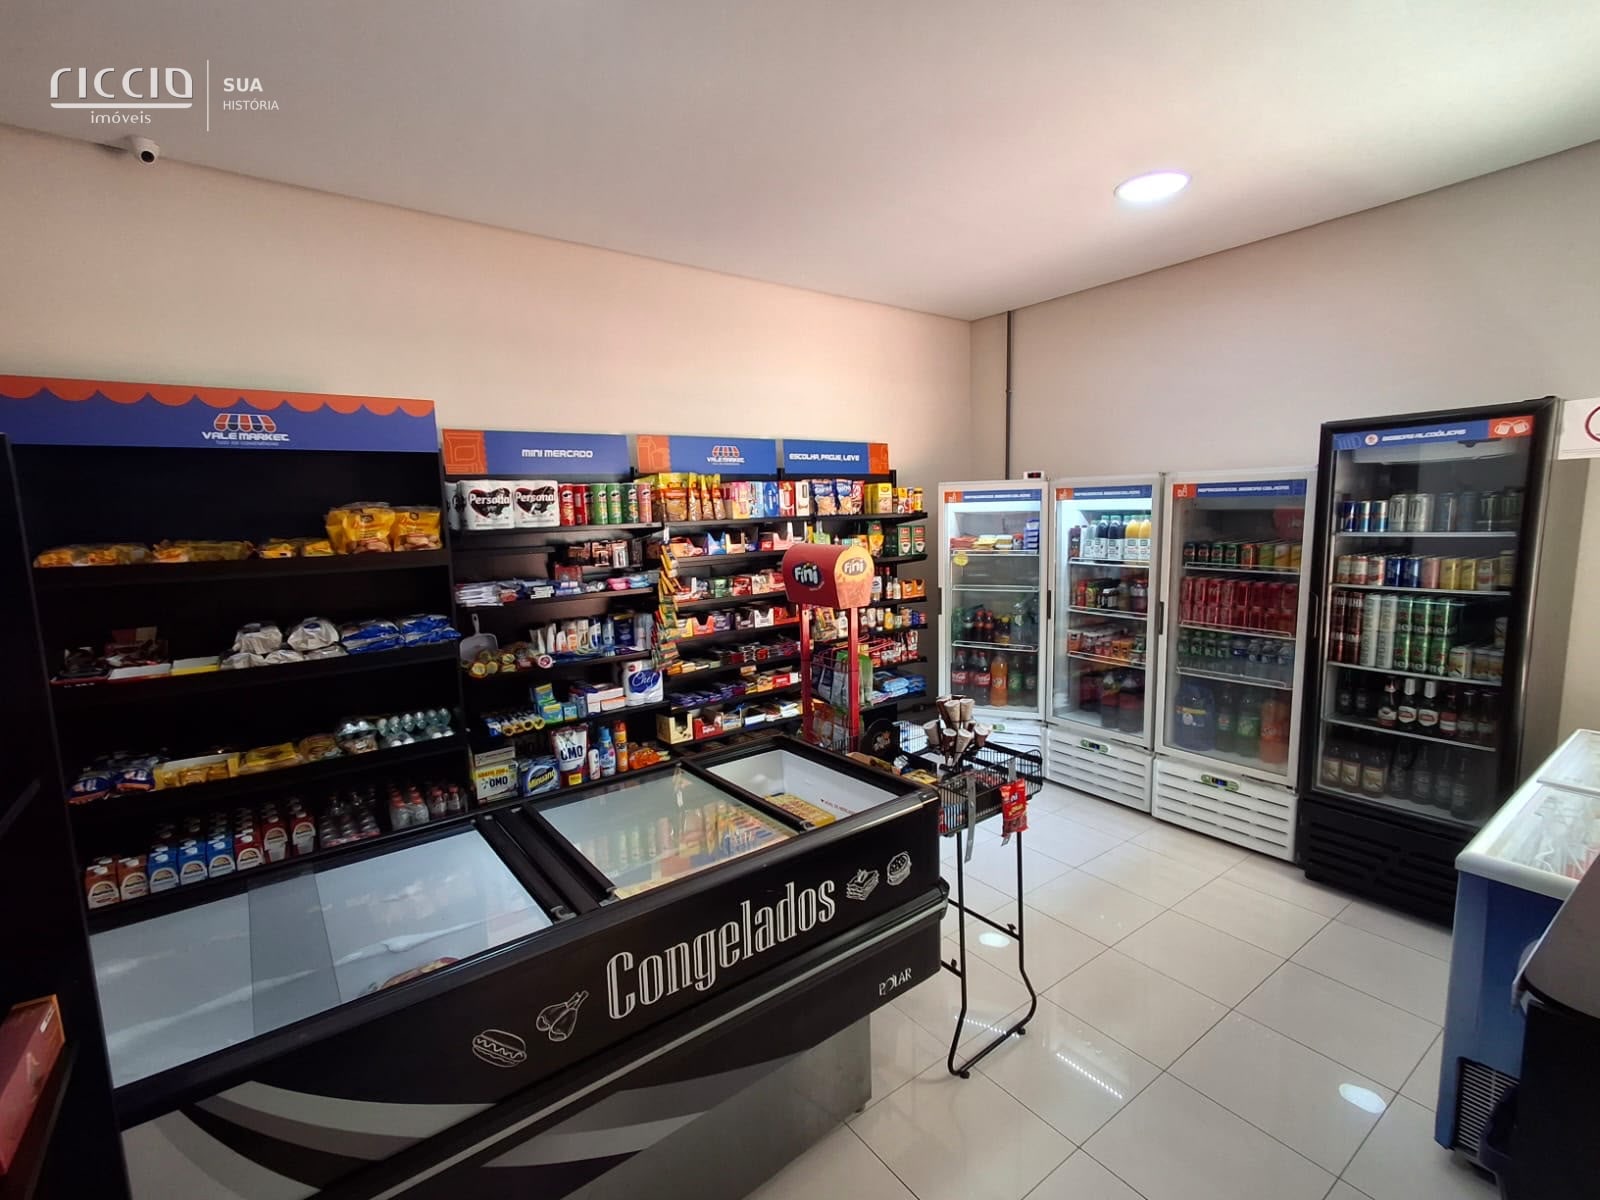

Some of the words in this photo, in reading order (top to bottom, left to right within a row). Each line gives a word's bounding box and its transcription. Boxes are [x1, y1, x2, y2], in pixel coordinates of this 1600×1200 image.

[201, 431, 238, 440] VALE
[521, 449, 543, 457] MINI
[544, 450, 593, 458] MERCADO
[794, 563, 819, 585] Fini
[844, 559, 865, 574] Fini
[560, 745, 583, 761] OMO
[489, 776, 508, 787] OMO
[606, 879, 837, 1020] Congelados
